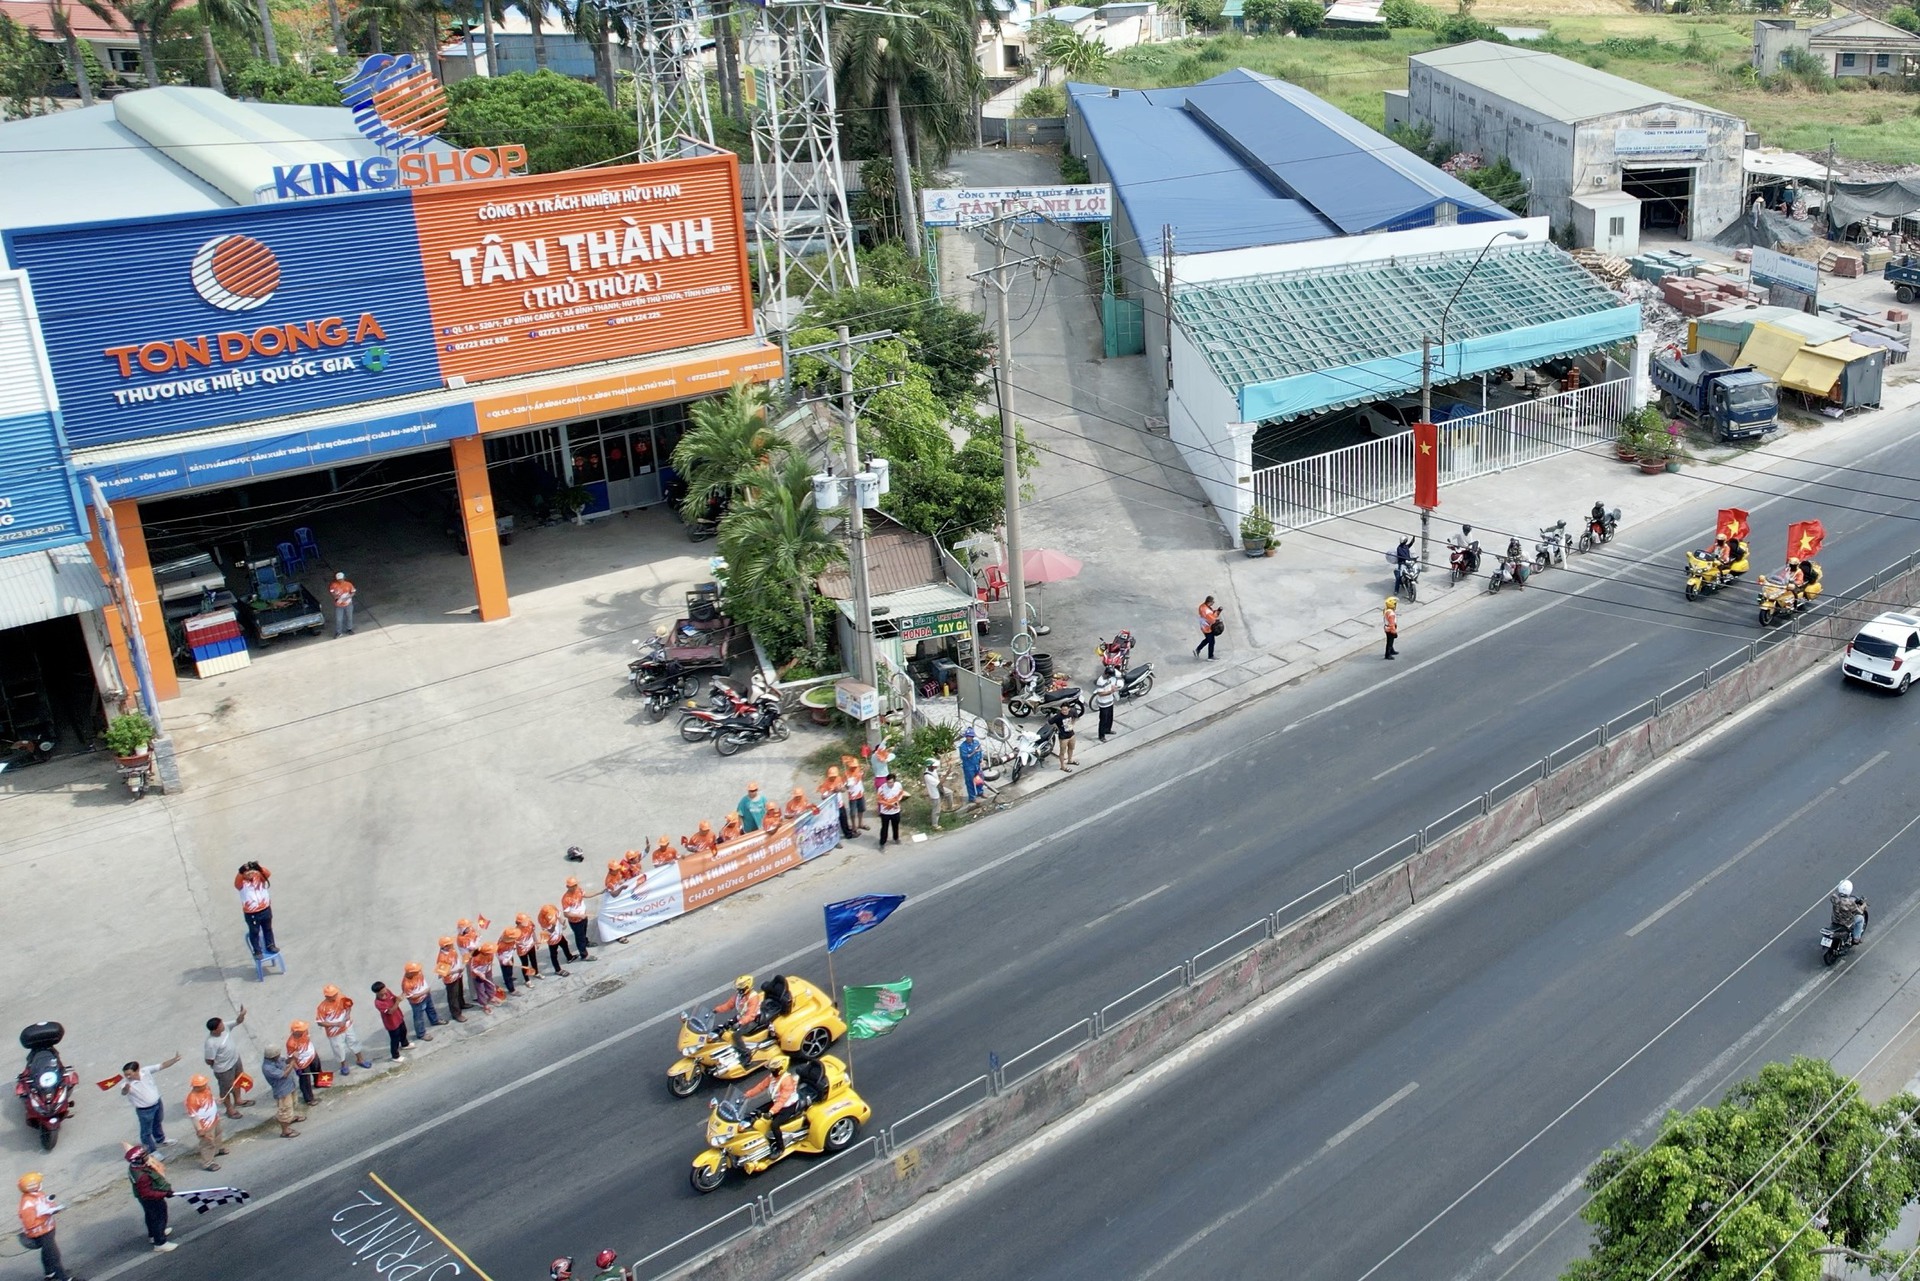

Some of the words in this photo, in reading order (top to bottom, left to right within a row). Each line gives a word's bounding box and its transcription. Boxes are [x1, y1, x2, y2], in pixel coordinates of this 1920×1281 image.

[479, 202, 516, 220] CÔNG
[516, 202, 536, 215] TY
[536, 194, 579, 213] TRÁCH
[581, 189, 620, 209] NHIỆM
[623, 186, 650, 202] HỮU
[653, 185, 681, 201] HẠN
[958, 191, 985, 199] CÔNG
[958, 199, 997, 214] TÂN
[1075, 195, 1106, 212] LỢI
[450, 233, 550, 287] TÂN
[560, 216, 714, 271] THÀNH
[702, 286, 720, 295] LONG
[105, 335, 211, 377] TON
[217, 317, 350, 364] DONG
[353, 312, 387, 342] A
[113, 377, 208, 406] THƯƠNG
[210, 368, 257, 394] HIỆU
[260, 357, 317, 384] QUỐC
[322, 356, 356, 374] GIA
[109, 476, 133, 487] LẠNH
[139, 472, 156, 481] TÔN
[902, 626, 932, 640] HONDA
[938, 622, 954, 634] TAY
[956, 620, 968, 630] GA
[688, 887, 715, 903] CHÀO
[717, 875, 745, 893] MỪNG
[747, 865, 773, 880] ĐOÀN
[774, 854, 793, 868] ĐUA
[610, 911, 633, 923] TON
[635, 898, 667, 915] DONG
[667, 895, 676, 905] A
